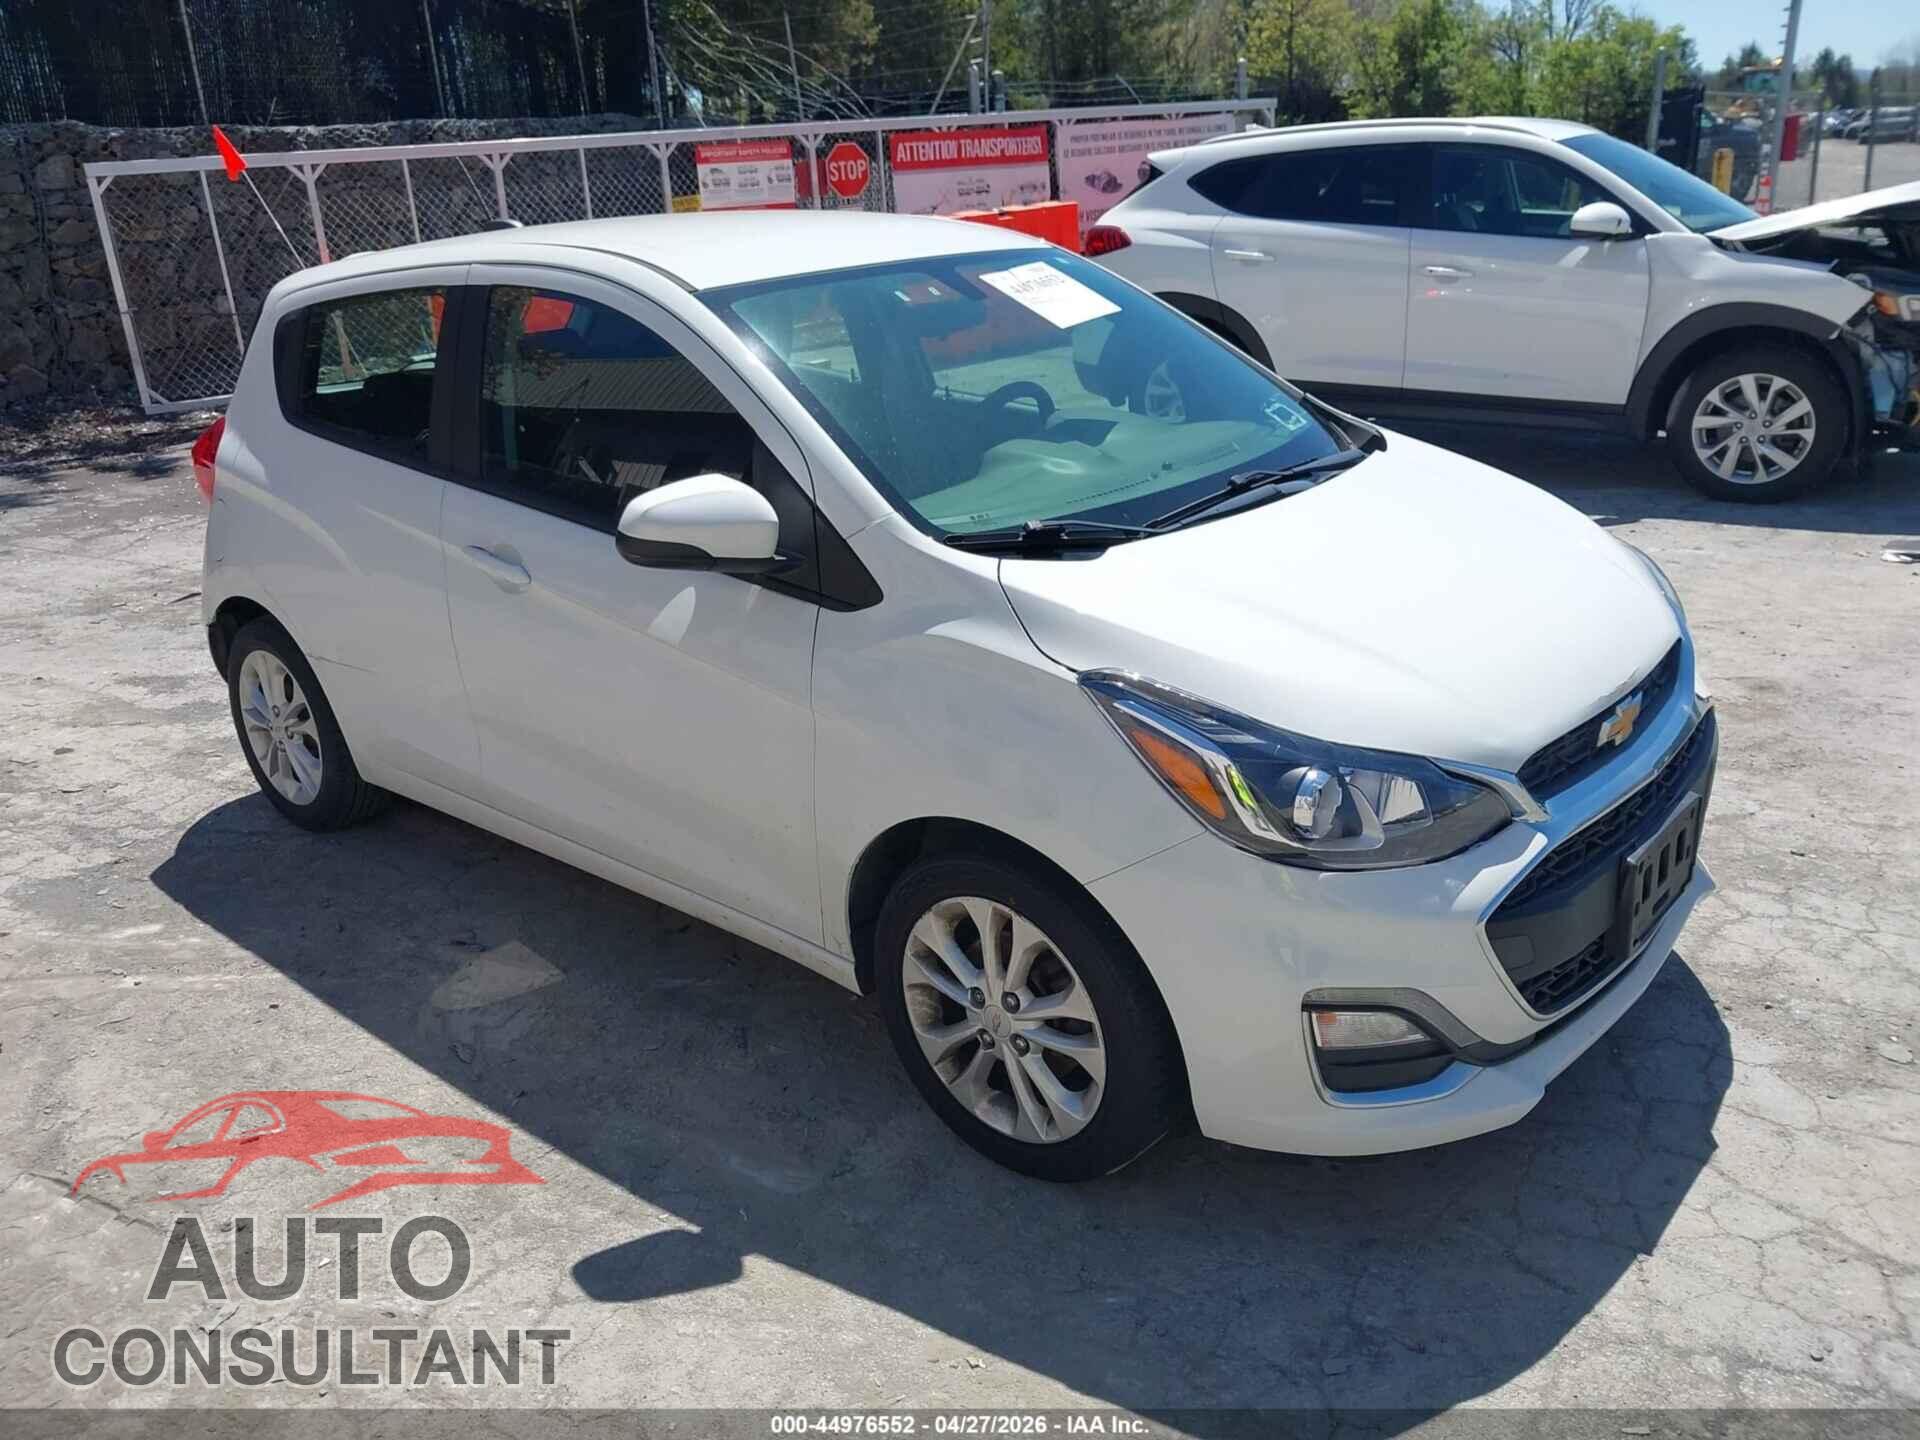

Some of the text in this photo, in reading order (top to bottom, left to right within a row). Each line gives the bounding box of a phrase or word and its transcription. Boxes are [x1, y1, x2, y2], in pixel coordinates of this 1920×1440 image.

[896, 139, 958, 162] ATTENTION
[960, 135, 1042, 158] TRANSPORTERS!
[829, 159, 867, 182] STOP
